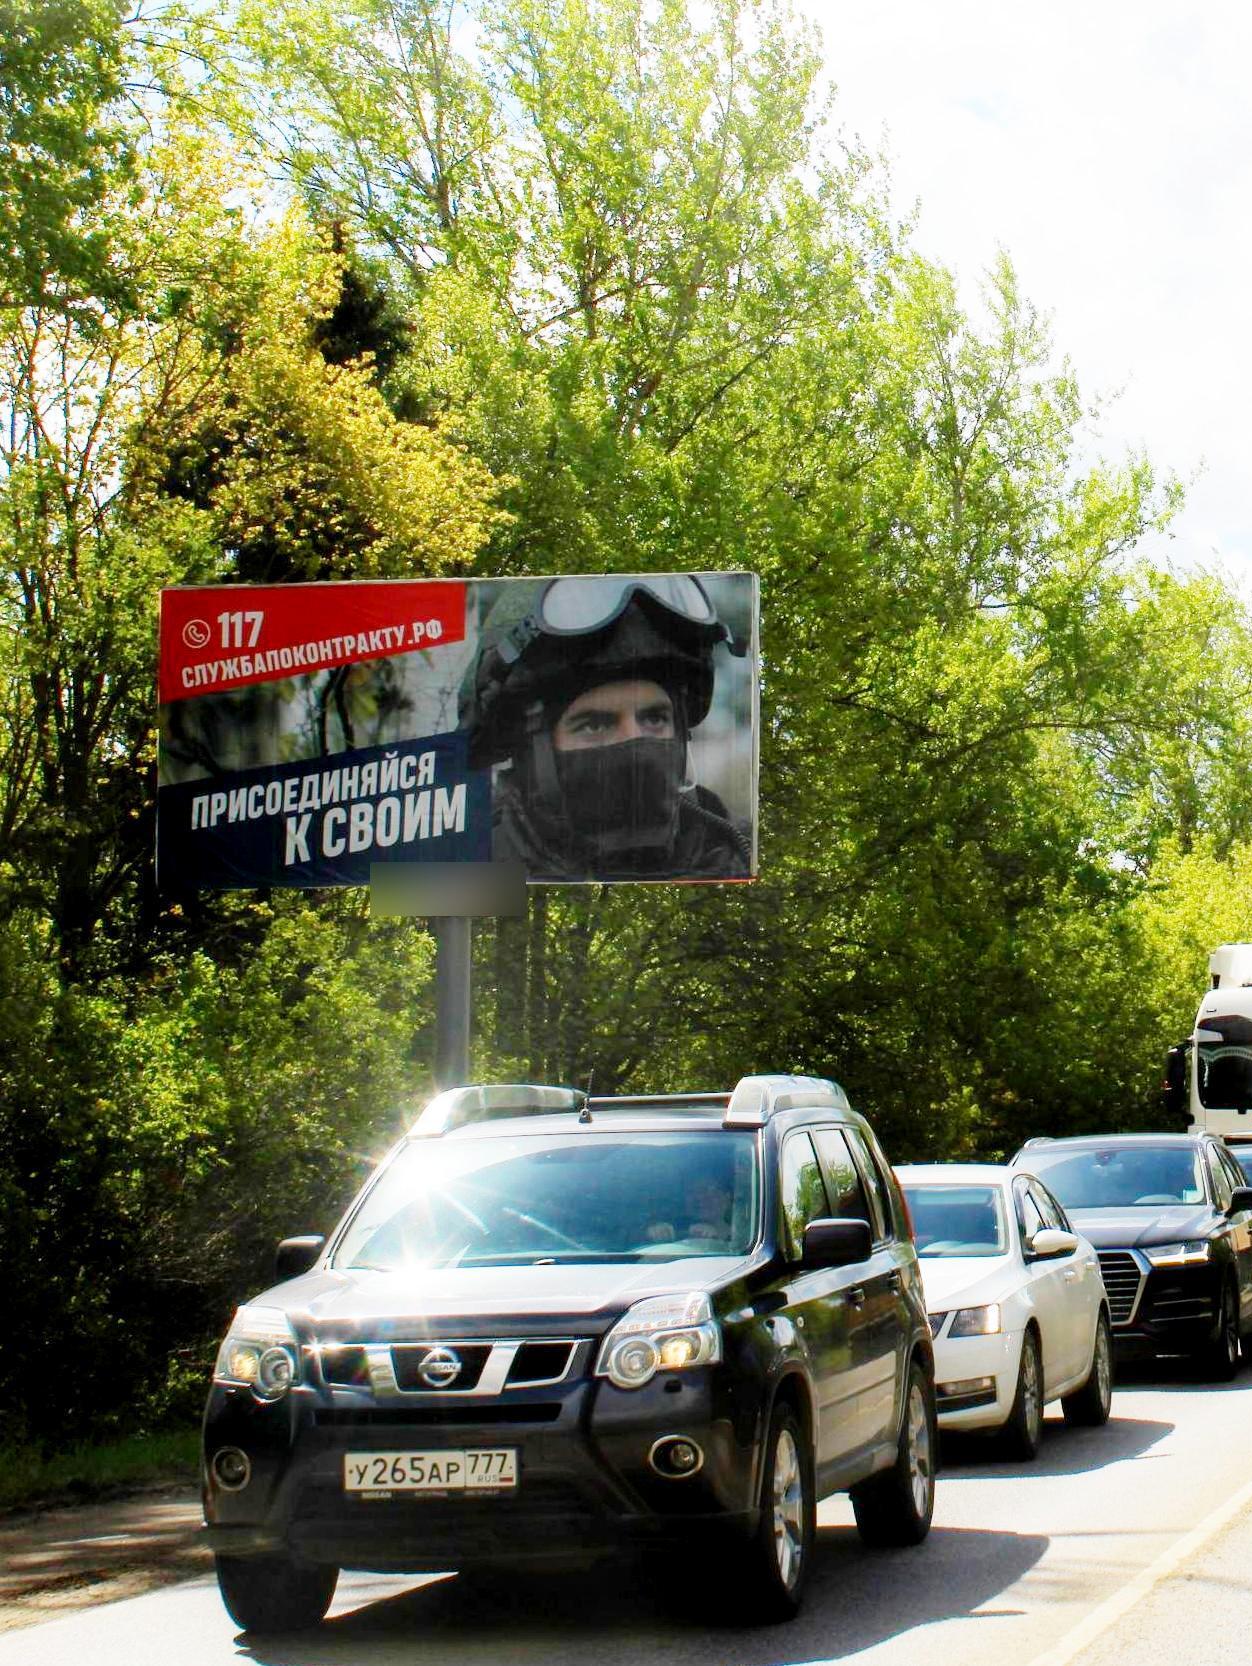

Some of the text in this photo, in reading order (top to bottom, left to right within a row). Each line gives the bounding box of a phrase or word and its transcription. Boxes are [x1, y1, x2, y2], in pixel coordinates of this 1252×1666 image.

[181, 618, 443, 688] СЛУЖБАПОКОНТРАКТУ.РФ
[217, 611, 264, 648] 117
[191, 750, 436, 830] ПРИСОЕДИНЯЙСЯ
[285, 783, 467, 866] К СВОИМ
[467, 1453, 508, 1474] 777
